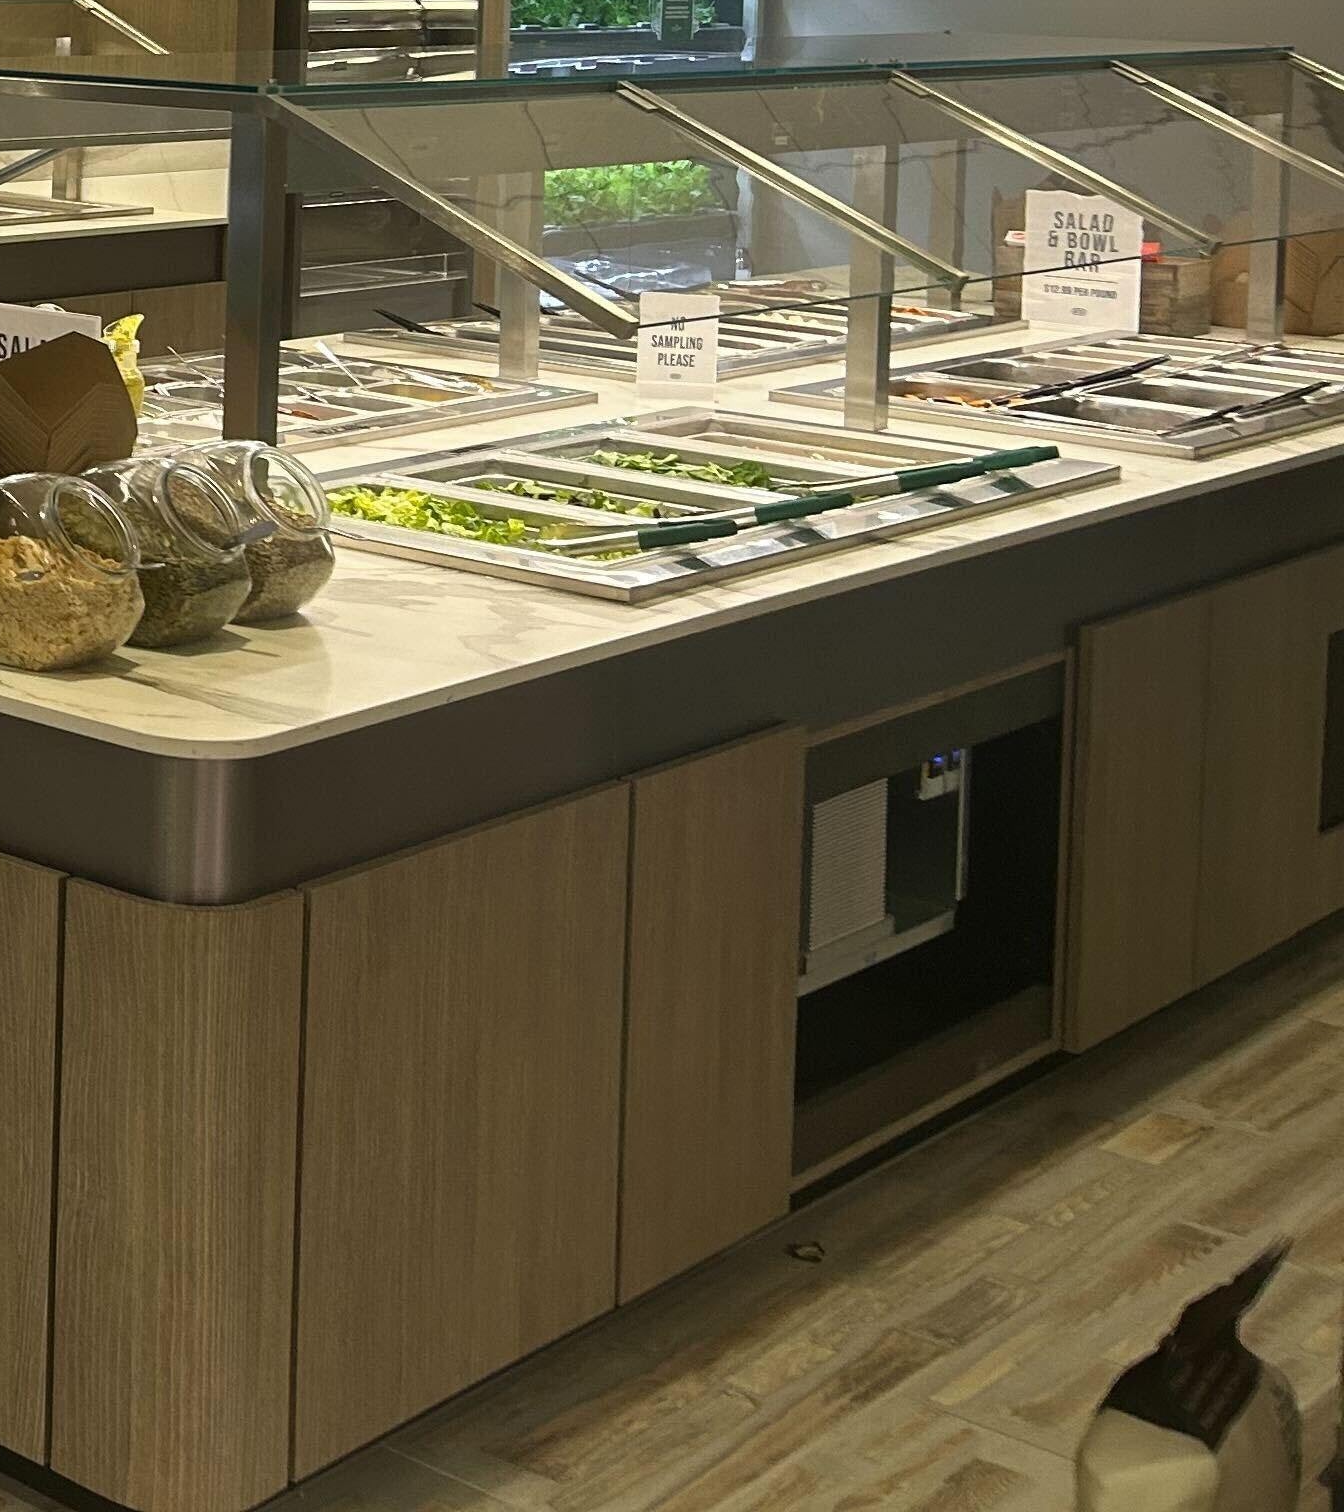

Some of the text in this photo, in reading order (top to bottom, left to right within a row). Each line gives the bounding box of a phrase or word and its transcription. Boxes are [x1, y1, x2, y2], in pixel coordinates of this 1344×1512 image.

[1053, 211, 1114, 233] SALAD
[1048, 230, 1119, 253] & BOWL
[1064, 250, 1100, 274] BAR
[1074, 286, 1089, 296] PER
[1090, 288, 1118, 299] POUND
[671, 316, 685, 331] NO
[651, 334, 704, 350] SAMPLING
[657, 352, 696, 368] PLEASE
